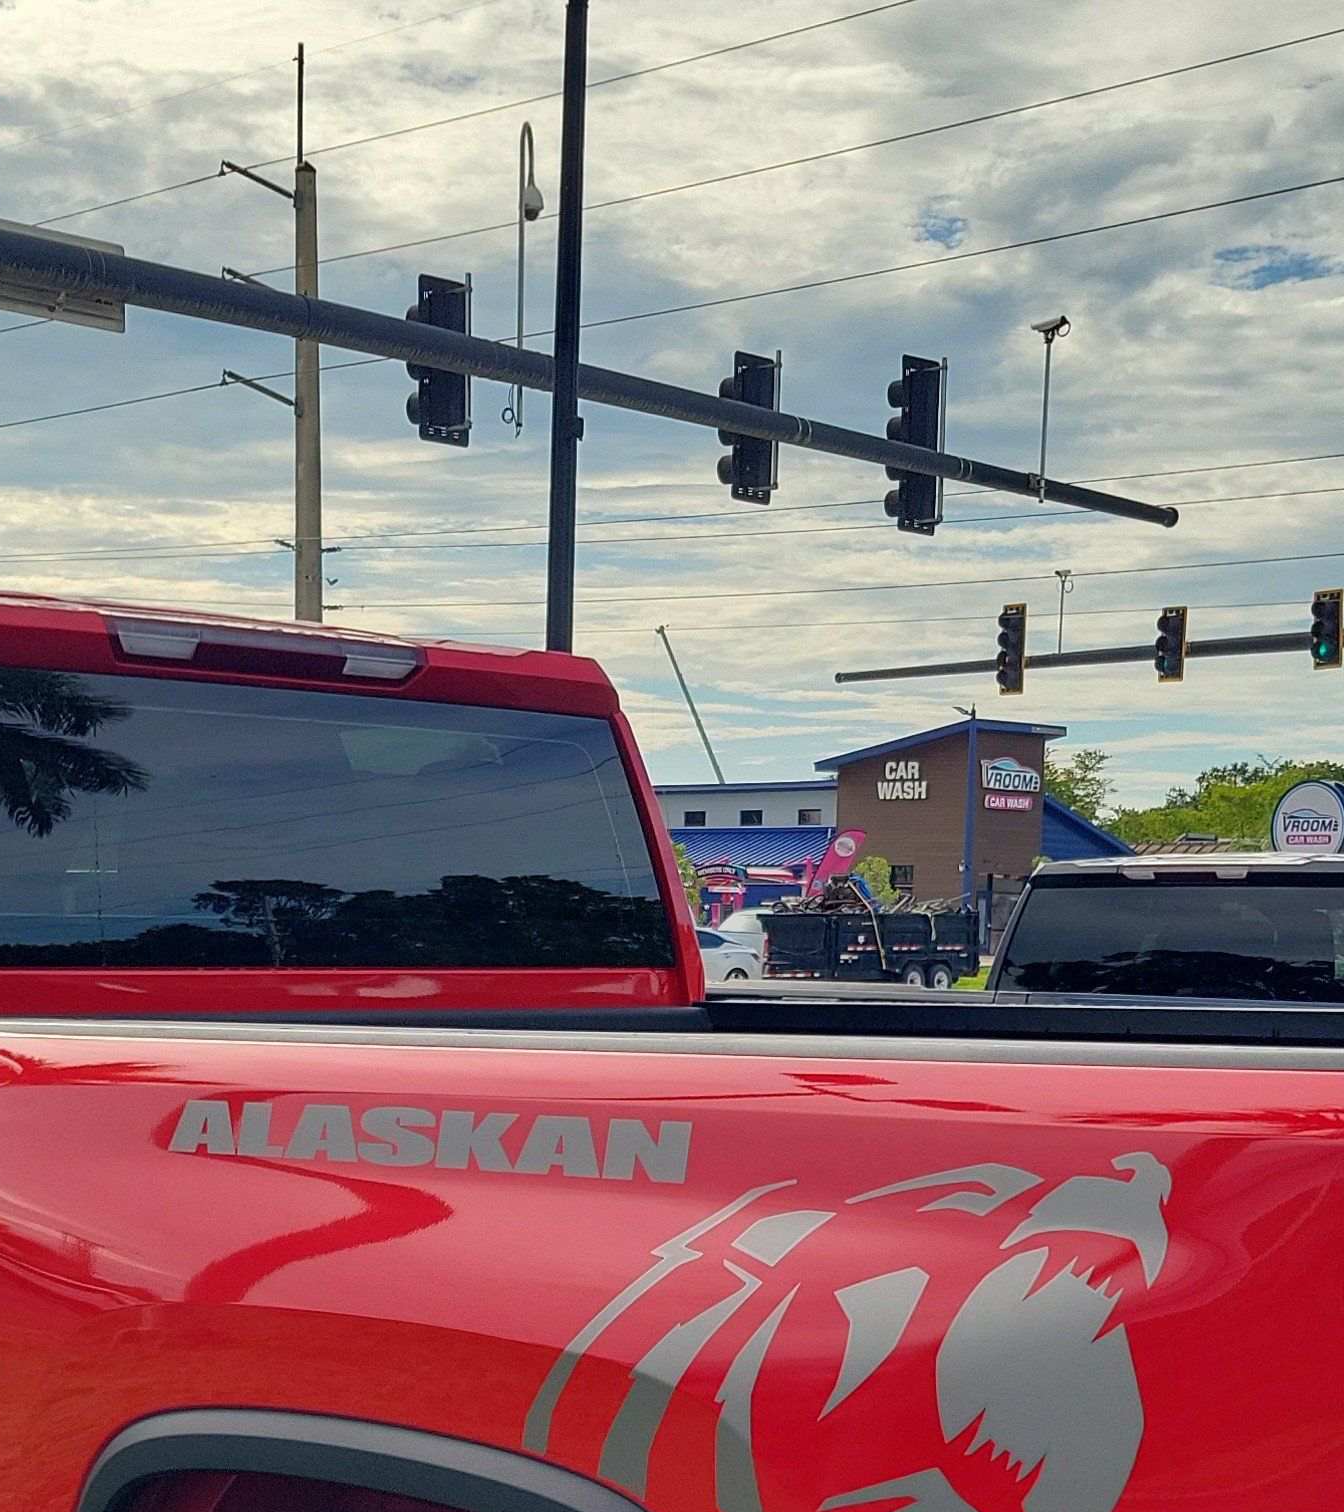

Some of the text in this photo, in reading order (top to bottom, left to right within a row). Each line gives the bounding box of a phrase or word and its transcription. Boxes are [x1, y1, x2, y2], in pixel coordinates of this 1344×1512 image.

[885, 761, 919, 780] CAR
[984, 764, 1034, 790] VROOM
[877, 781, 928, 800] WASH
[989, 796, 1029, 809] CAR WASH
[1282, 815, 1332, 833] VROOM
[1288, 835, 1330, 845] CAR WASH
[167, 1099, 693, 1184] ALASKAN
